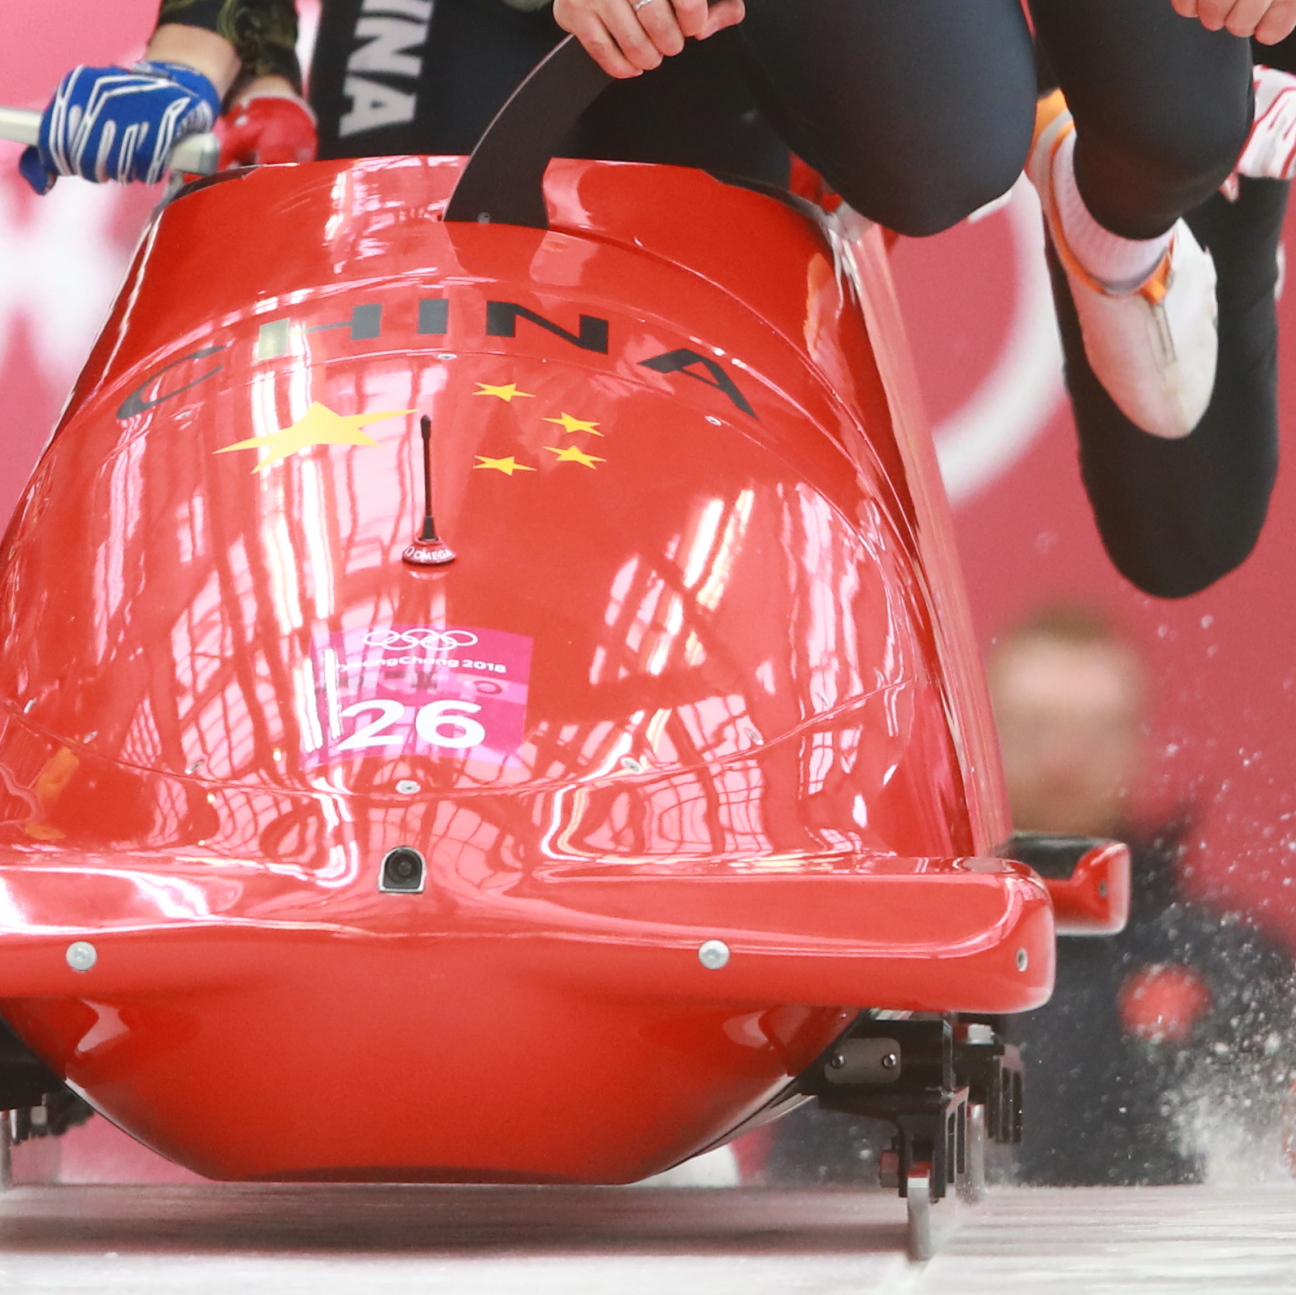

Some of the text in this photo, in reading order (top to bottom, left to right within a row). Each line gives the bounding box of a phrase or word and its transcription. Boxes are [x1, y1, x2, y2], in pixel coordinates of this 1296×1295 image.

[115, 297, 759, 421] CHINA
[334, 655, 507, 673] yeongChang 2018
[336, 699, 486, 751] 26
